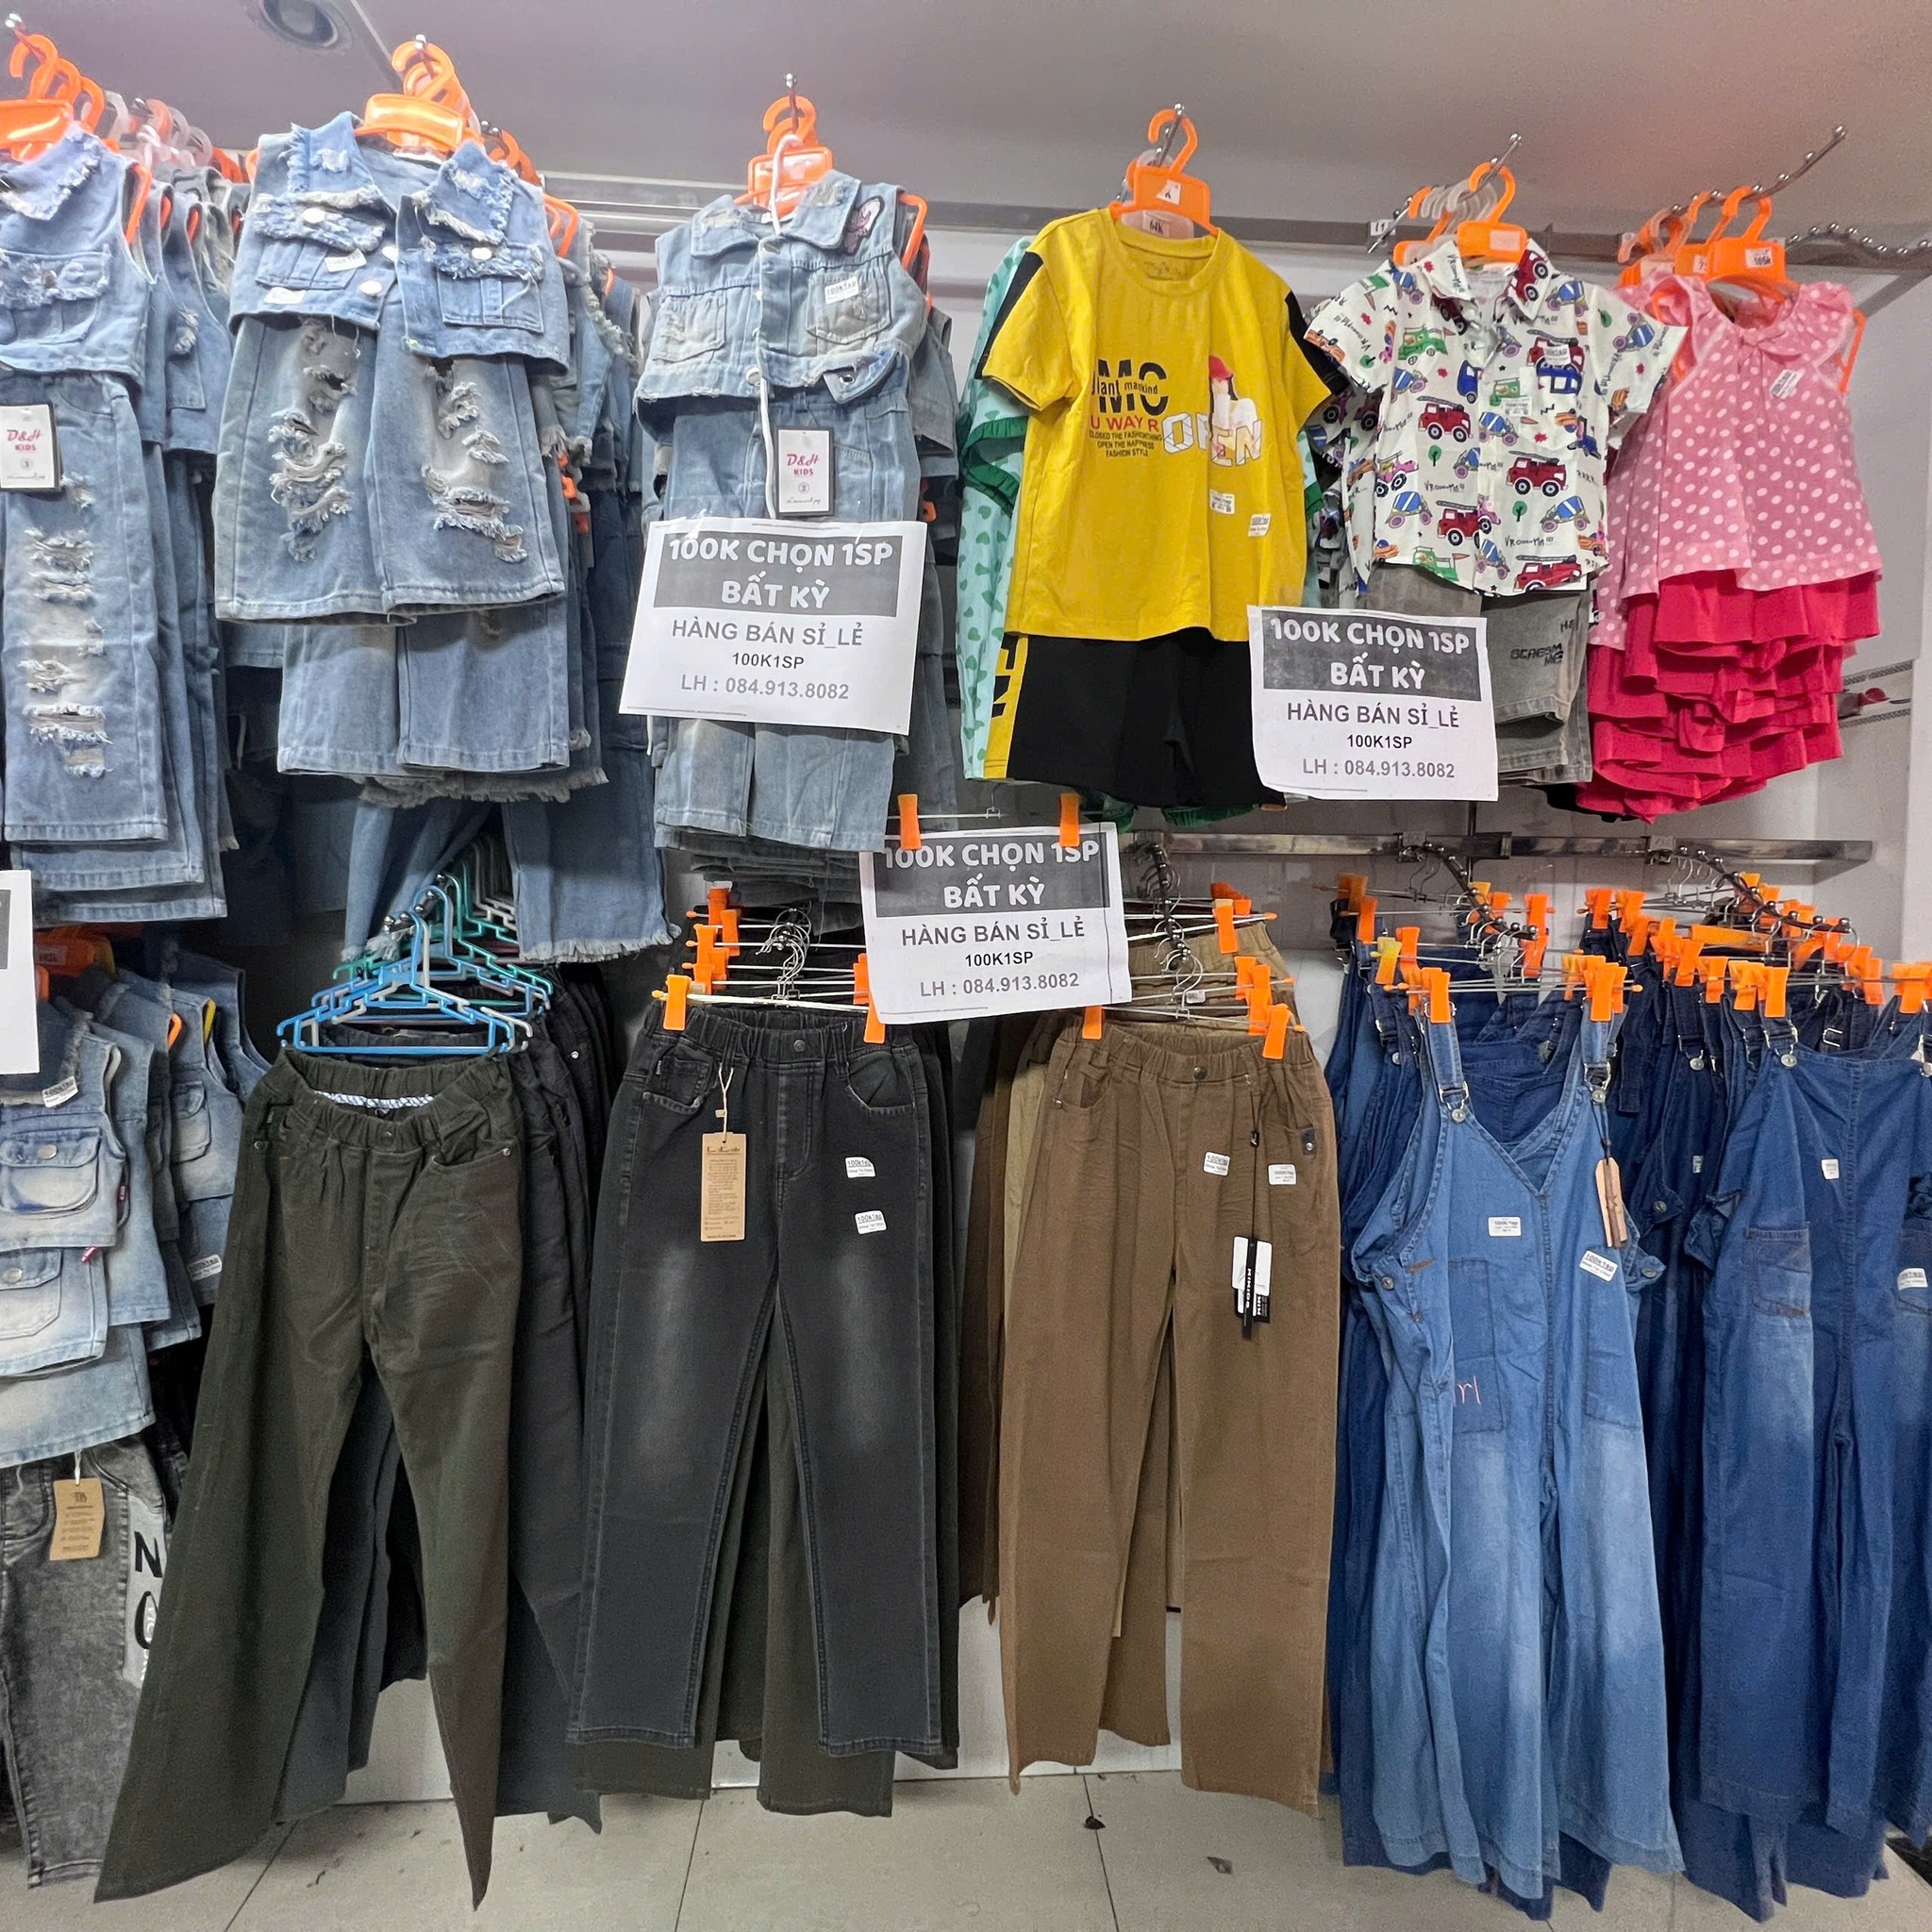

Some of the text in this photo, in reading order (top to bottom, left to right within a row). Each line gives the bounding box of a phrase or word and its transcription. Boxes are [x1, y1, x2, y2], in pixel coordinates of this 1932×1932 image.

[1090, 414, 1160, 433] U WAY R
[1160, 411, 1263, 468] OPEN
[787, 453, 821, 467] D&H
[793, 468, 814, 476] KIDS
[669, 537, 893, 574] 100K CHỌN 1SP
[721, 569, 831, 609] BẤT KỲ
[672, 615, 739, 641] HÀNG
[745, 622, 795, 645] BÁN
[1269, 617, 1471, 656] 100K CHỌN 1SP
[732, 652, 805, 671] 100K1SP
[1329, 651, 1426, 691] BẤT KỲ
[681, 674, 708, 692] LH
[724, 676, 850, 701] 084.913.8082
[1286, 697, 1350, 724] HÀNG
[1356, 702, 1402, 726] BÁN
[1346, 734, 1413, 750] 100K1SP
[1302, 758, 1327, 774] LH
[1343, 758, 1456, 779] 084.913.8082
[885, 839, 1100, 873] 100K CHỌN 1SP
[943, 873, 1046, 909] BẤT KỲ
[901, 923, 968, 947] HÀNG
[974, 921, 1021, 943] BÁN
[964, 950, 1034, 968] 100K1SP
[920, 980, 945, 998] LH
[962, 971, 1080, 996] 084.913.8082
